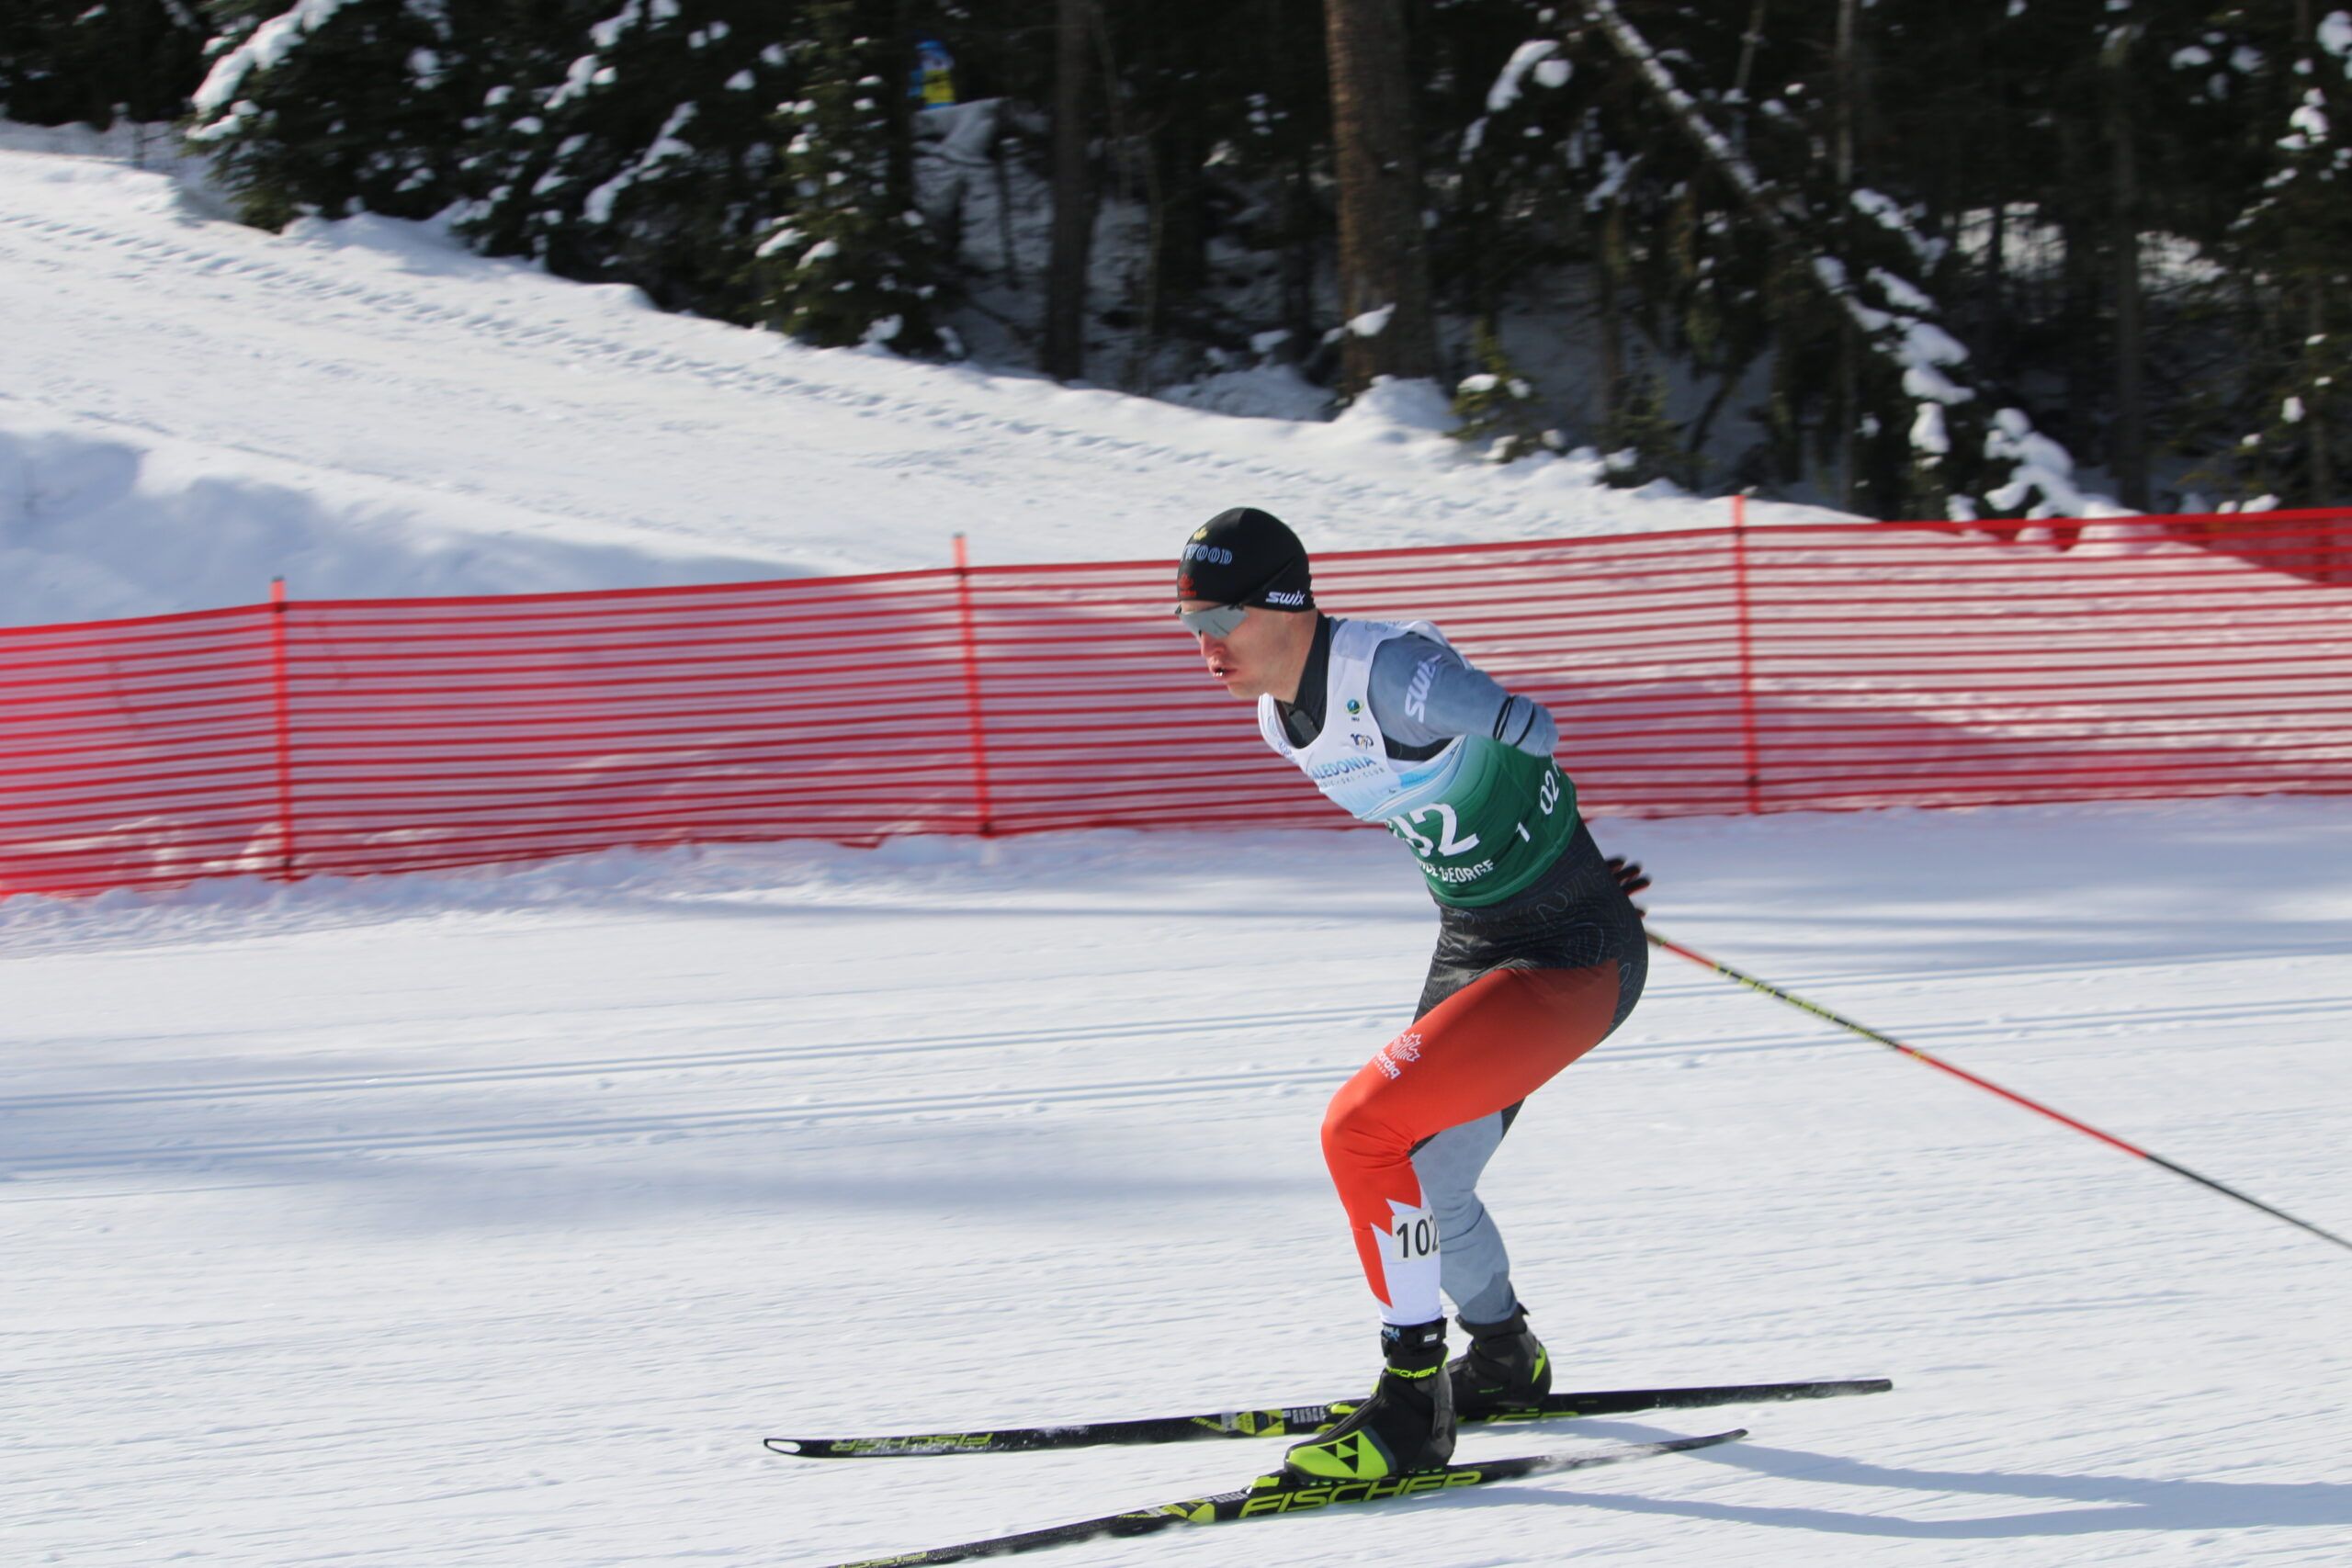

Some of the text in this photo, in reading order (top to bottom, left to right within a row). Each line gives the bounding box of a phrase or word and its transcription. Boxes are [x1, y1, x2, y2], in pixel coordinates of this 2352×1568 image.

[1182, 544, 1233, 565] WOOD
[1396, 1213, 1440, 1258] 102
[1238, 1471, 1482, 1518] FISCHER
